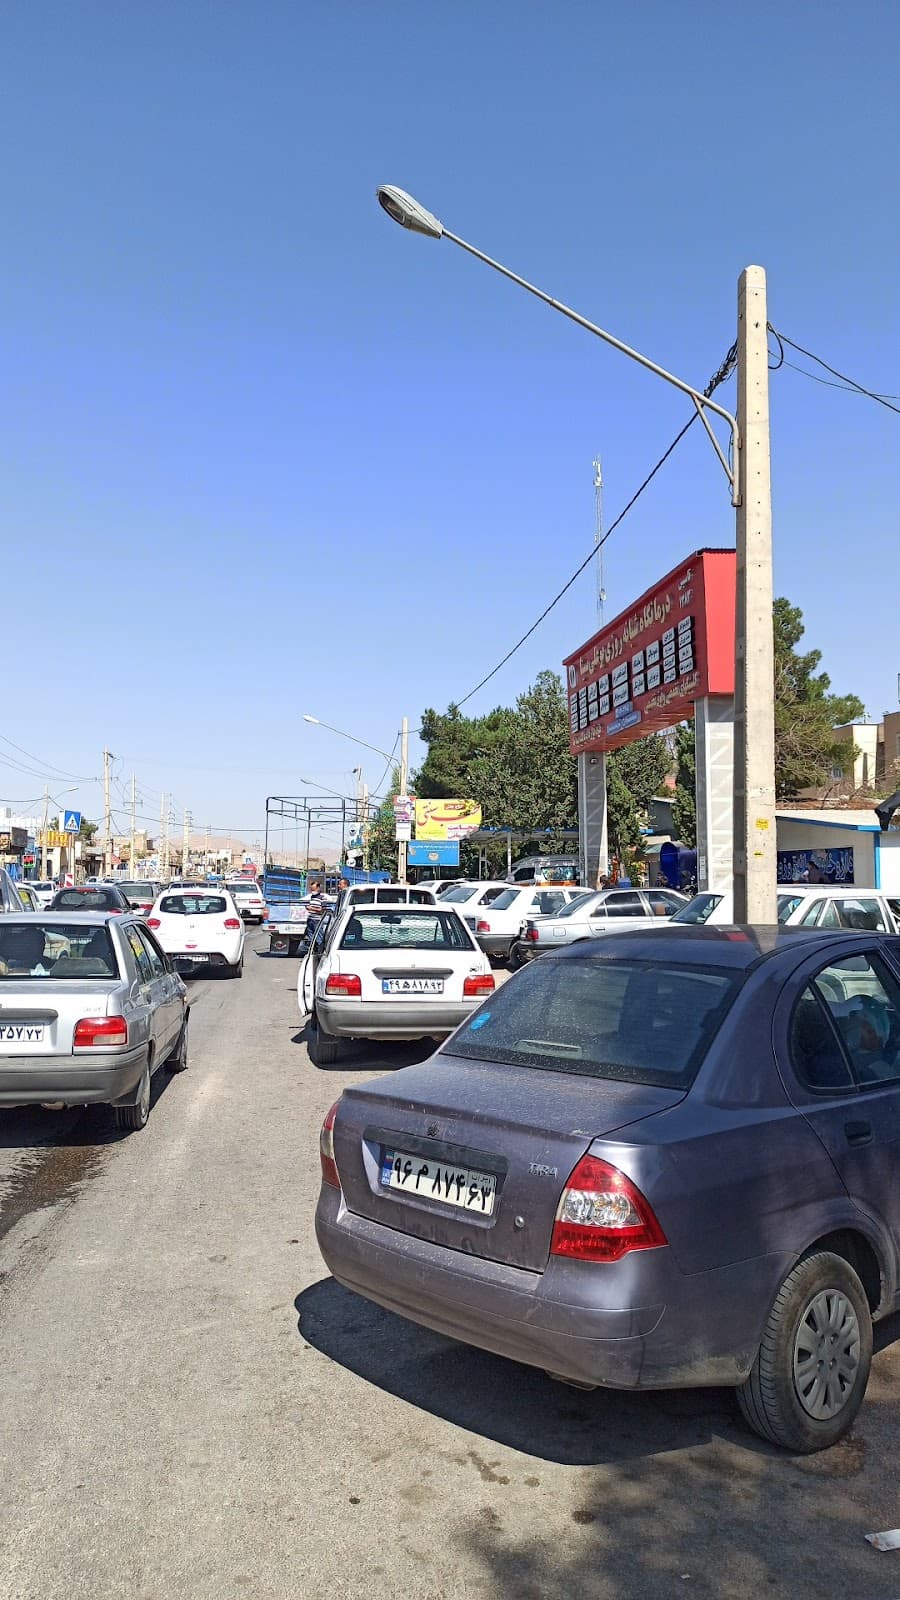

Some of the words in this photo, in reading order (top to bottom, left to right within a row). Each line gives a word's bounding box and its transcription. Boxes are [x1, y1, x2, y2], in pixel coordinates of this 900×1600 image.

[639, 595, 671, 631] درمانگاه
[394, 1157, 413, 1185] ۹۶
[415, 1164, 429, 1189] م
[431, 1167, 466, 1201] ۸۷۴
[467, 1183, 492, 1210] ۶۳
